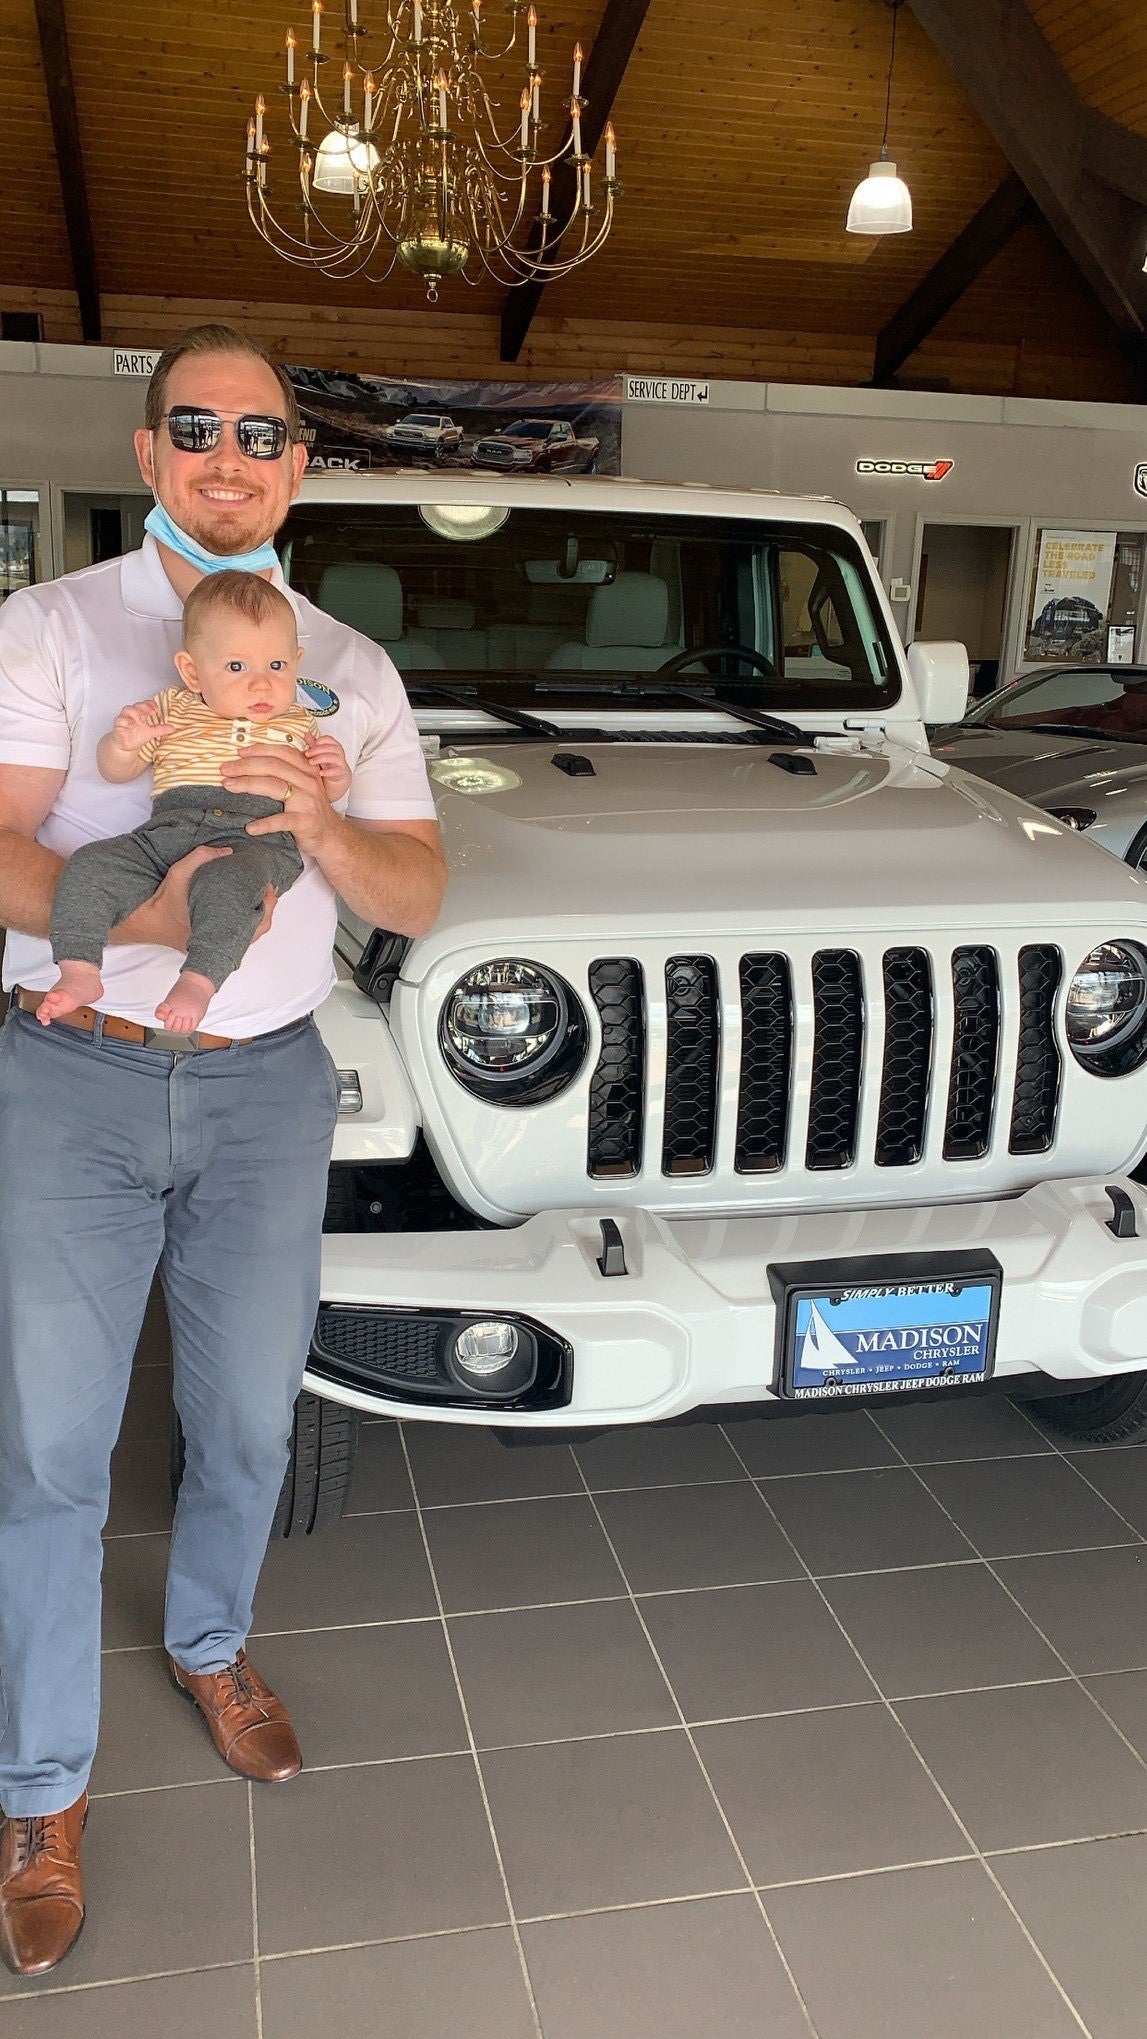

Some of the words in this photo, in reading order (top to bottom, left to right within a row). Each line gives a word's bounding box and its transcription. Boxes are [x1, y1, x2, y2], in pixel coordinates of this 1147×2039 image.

[116, 354, 153, 374] PARTS
[629, 380, 667, 399] SERVICE
[671, 383, 696, 401] DEPT
[858, 462, 937, 474] DODGE
[1045, 541, 1105, 552] CELEBRATE
[1045, 551, 1064, 560] THE
[1067, 552, 1096, 561] ROAD
[1042, 569, 1097, 580] TRAVELED
[841, 1287, 895, 1301] SIMPLY
[897, 1282, 955, 1297] BETTER
[856, 1324, 983, 1353] MADISON
[913, 1345, 980, 1361] CHRYSLER
[822, 1367, 866, 1377] CHRYSLER
[875, 1365, 895, 1374] JEEP
[904, 1362, 933, 1371] DODGE
[942, 1359, 960, 1368] RAM
[794, 1384, 843, 1399] MADISON
[844, 1379, 899, 1396] CHRYSLER
[900, 1379, 925, 1390] JEEP
[925, 1374, 961, 1388] DODGE
[962, 1372, 985, 1384] RAM
